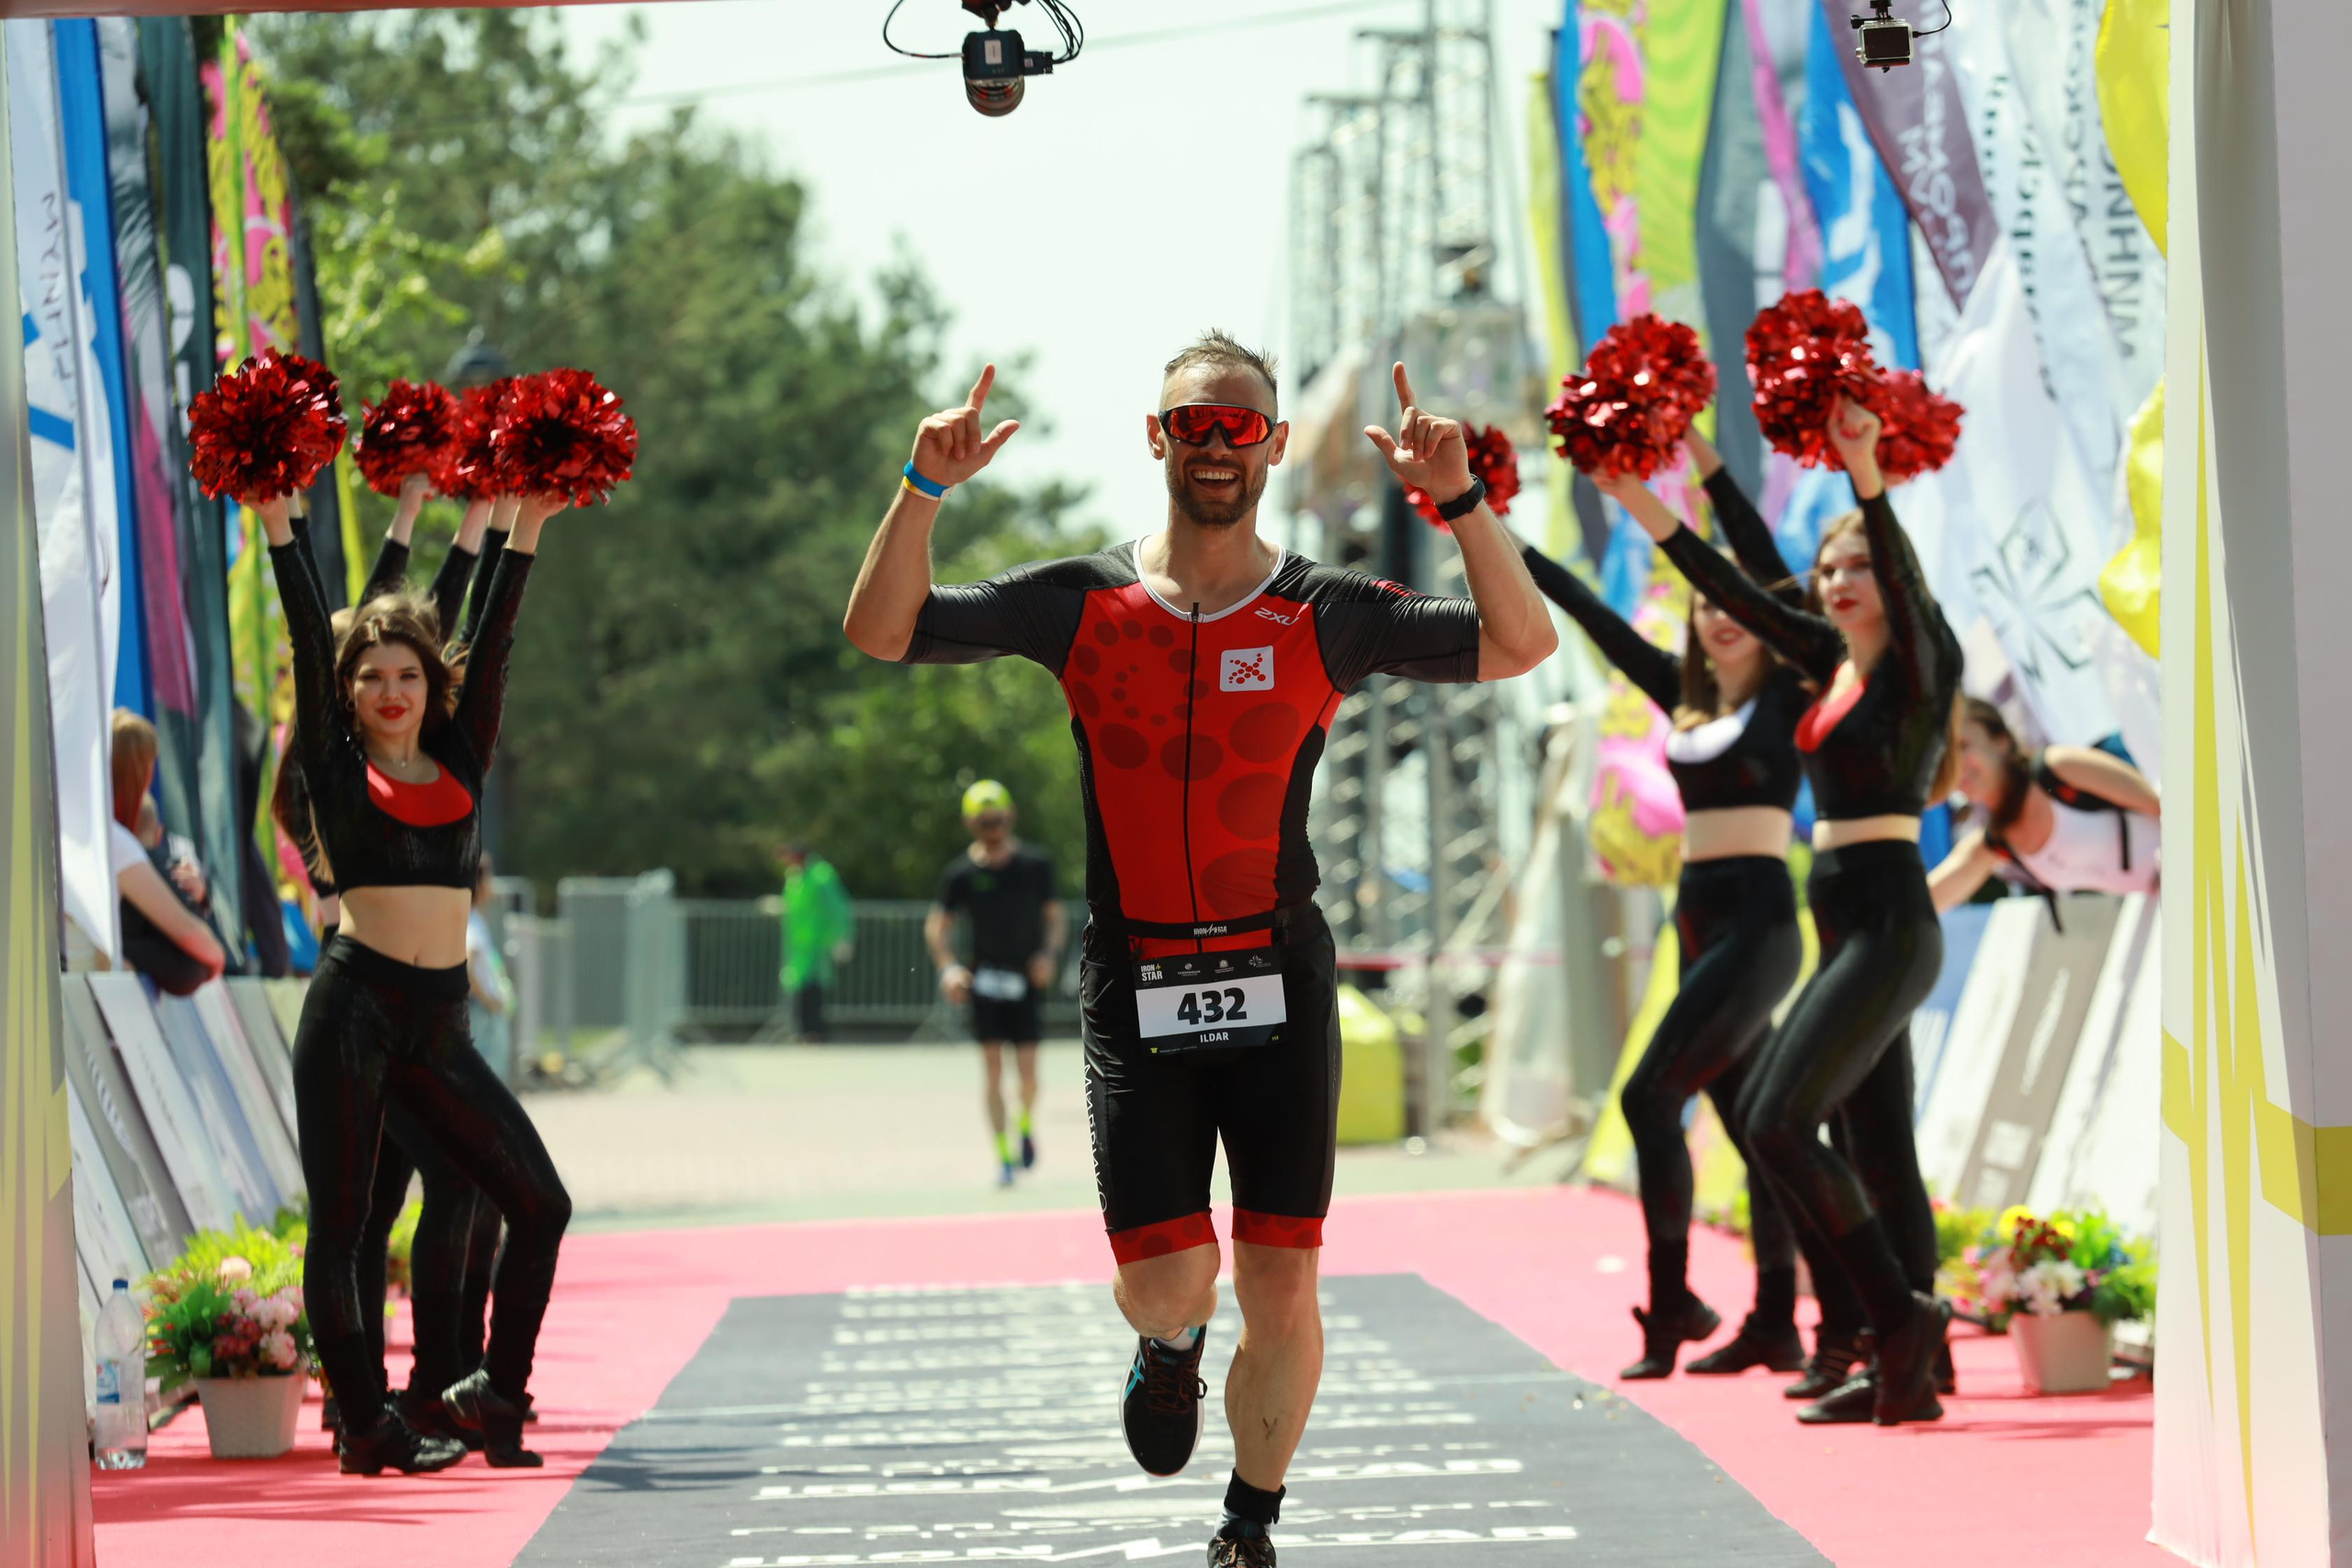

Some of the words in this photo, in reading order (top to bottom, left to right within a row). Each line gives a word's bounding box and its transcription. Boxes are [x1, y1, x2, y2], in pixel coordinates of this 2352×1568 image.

[1254, 607, 1299, 626] 2XU
[1141, 964, 1156, 973] IRON
[1142, 971, 1163, 982] STAR
[1177, 987, 1247, 1025] 432
[1200, 1032, 1229, 1043] ILDAR
